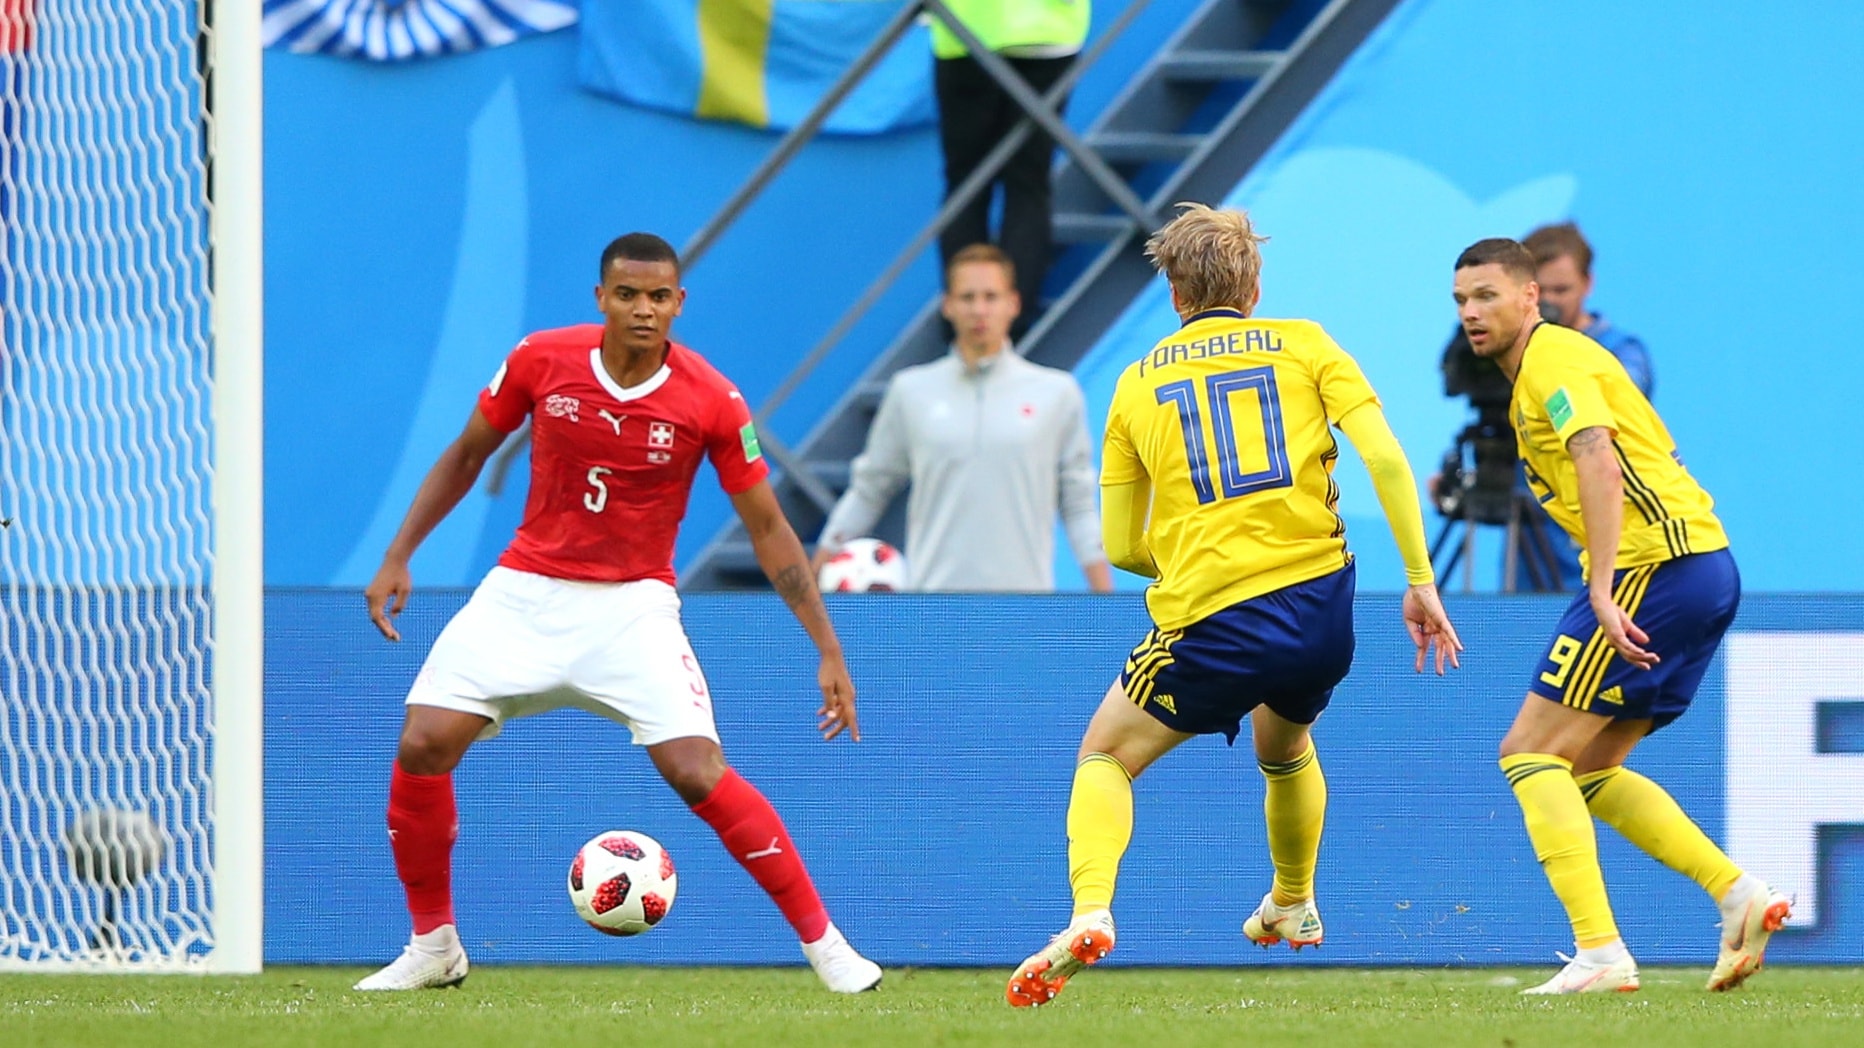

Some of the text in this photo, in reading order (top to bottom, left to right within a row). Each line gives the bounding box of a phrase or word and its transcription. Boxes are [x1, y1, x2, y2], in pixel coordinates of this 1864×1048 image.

[1139, 329, 1282, 378] FORSBERG
[1154, 364, 1294, 505] 10
[583, 466, 612, 513] 5
[1540, 634, 1583, 688] 9
